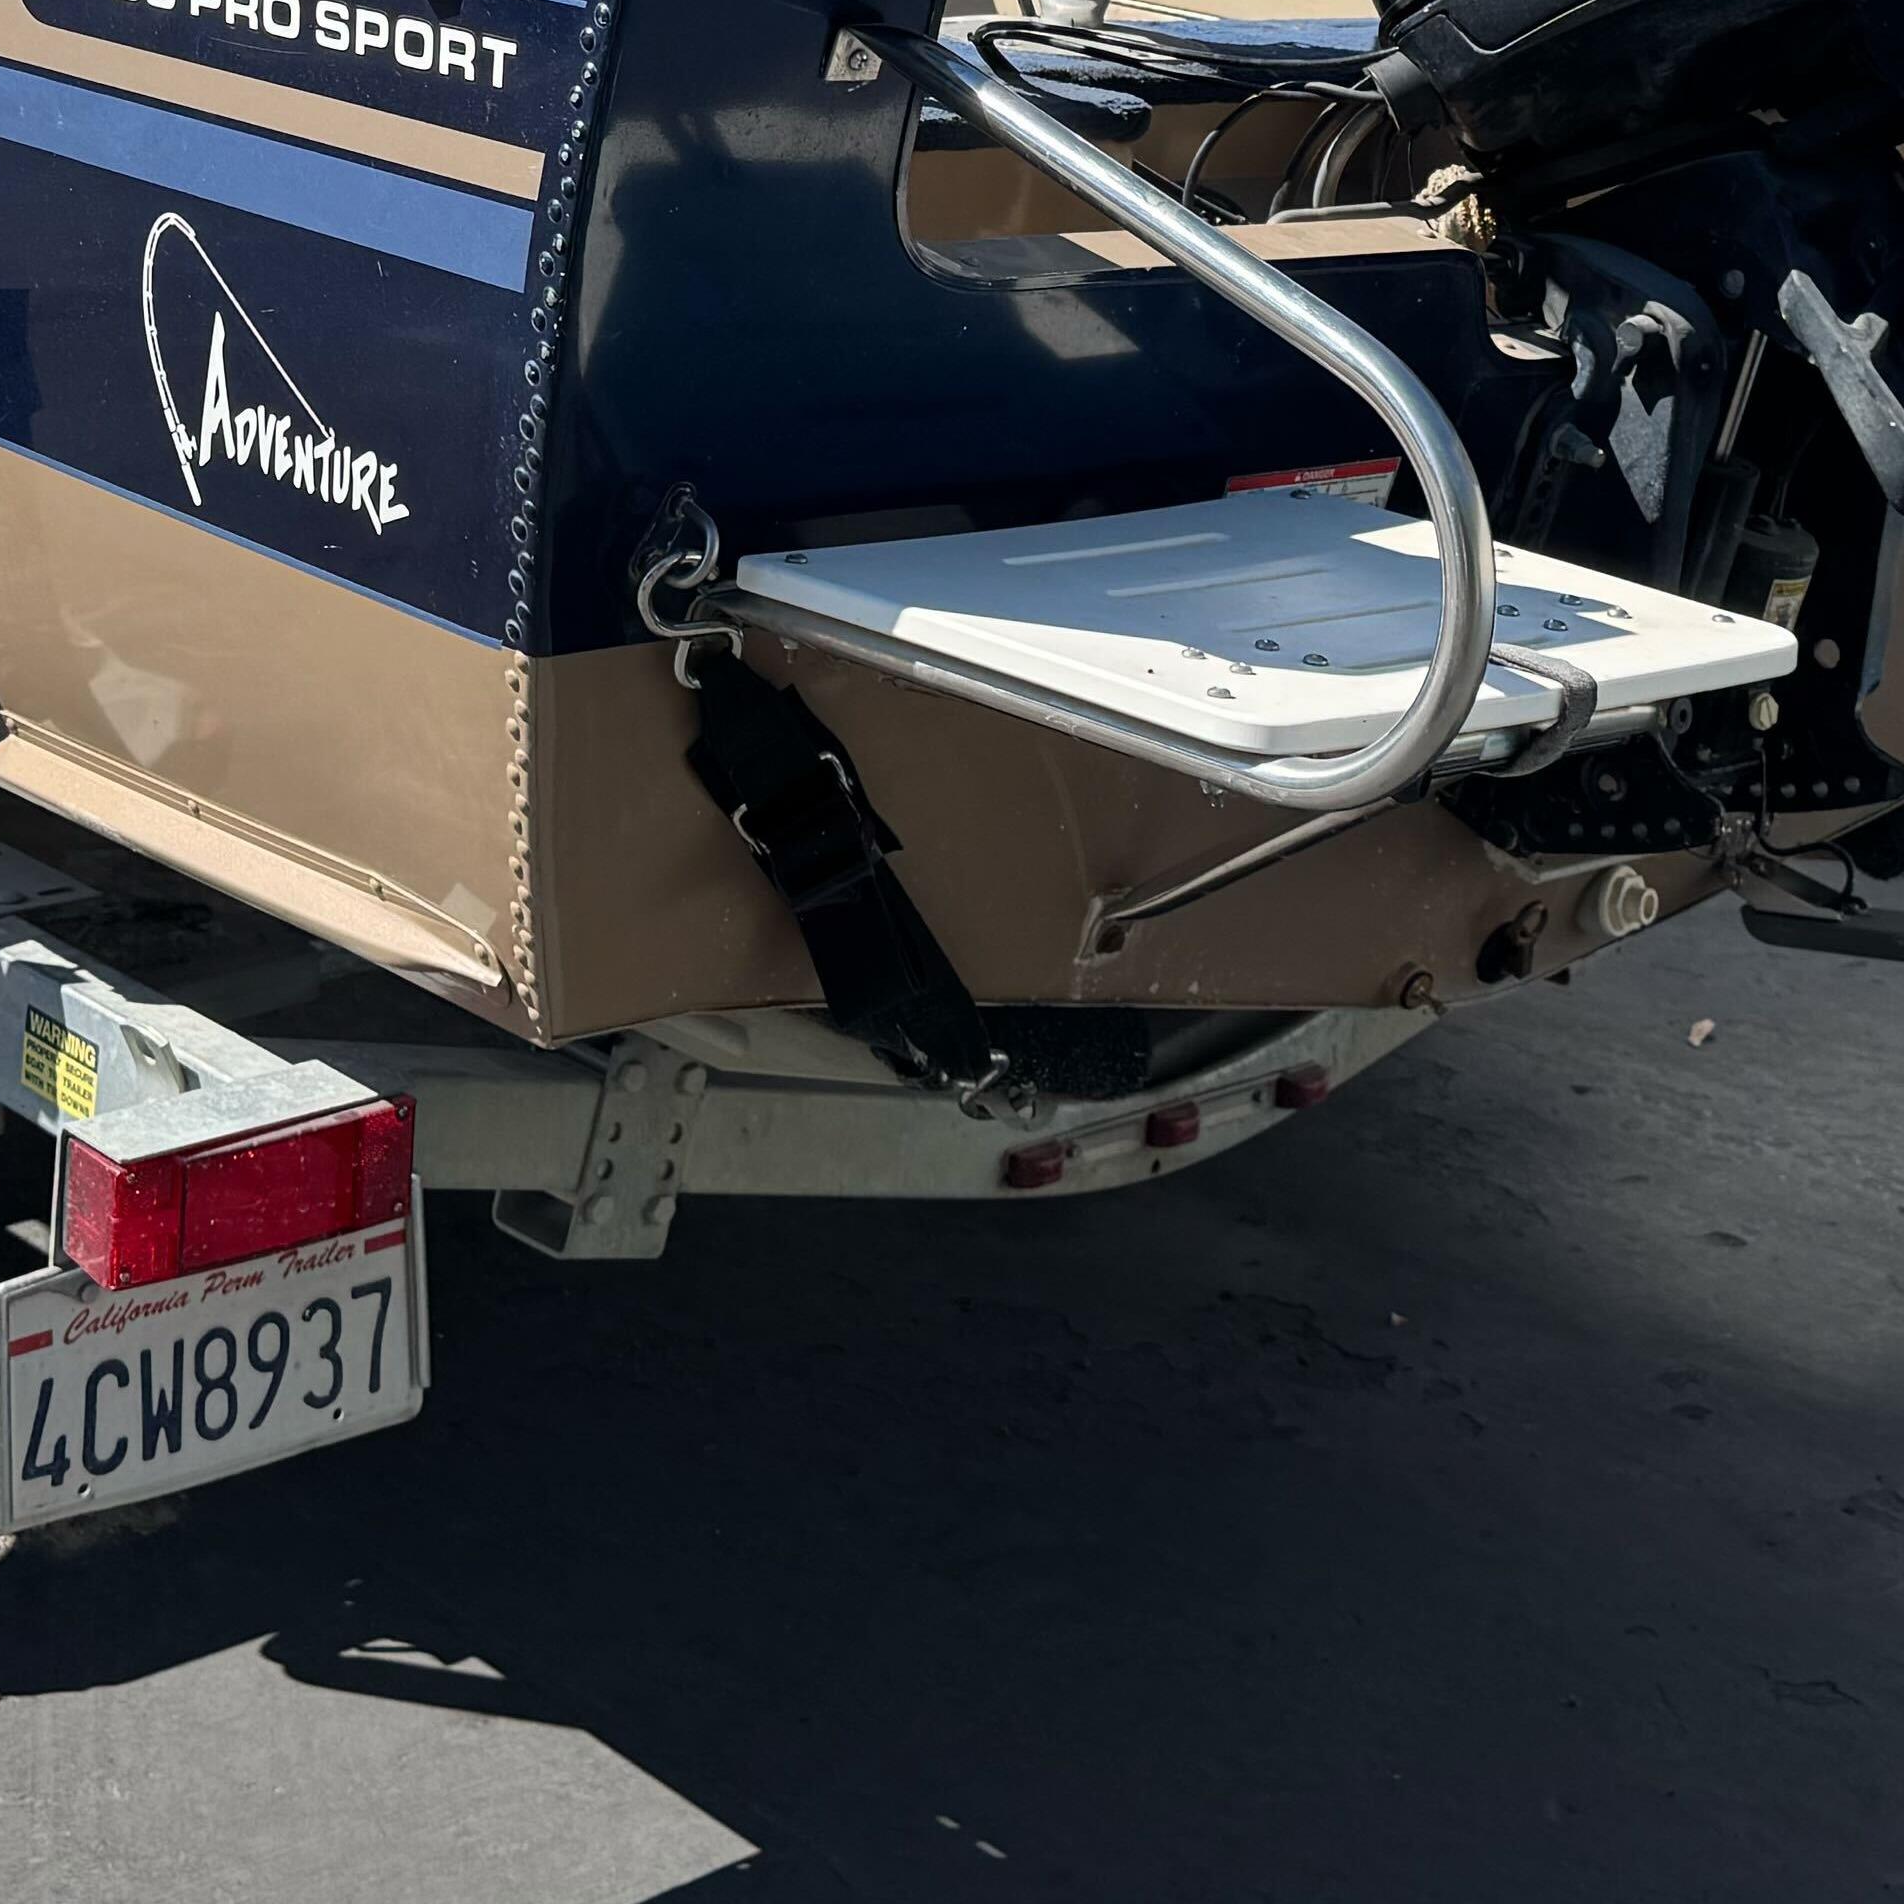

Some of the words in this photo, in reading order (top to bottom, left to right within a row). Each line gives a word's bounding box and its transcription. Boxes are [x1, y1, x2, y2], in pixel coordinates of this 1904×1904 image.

[314, 0, 518, 89] SPORT
[29, 1010, 97, 1069] WARNING
[62, 1289, 191, 1346] California
[201, 1269, 266, 1303] Perm
[278, 1239, 356, 1279] Trailer
[20, 1275, 393, 1488] 4CW8937
